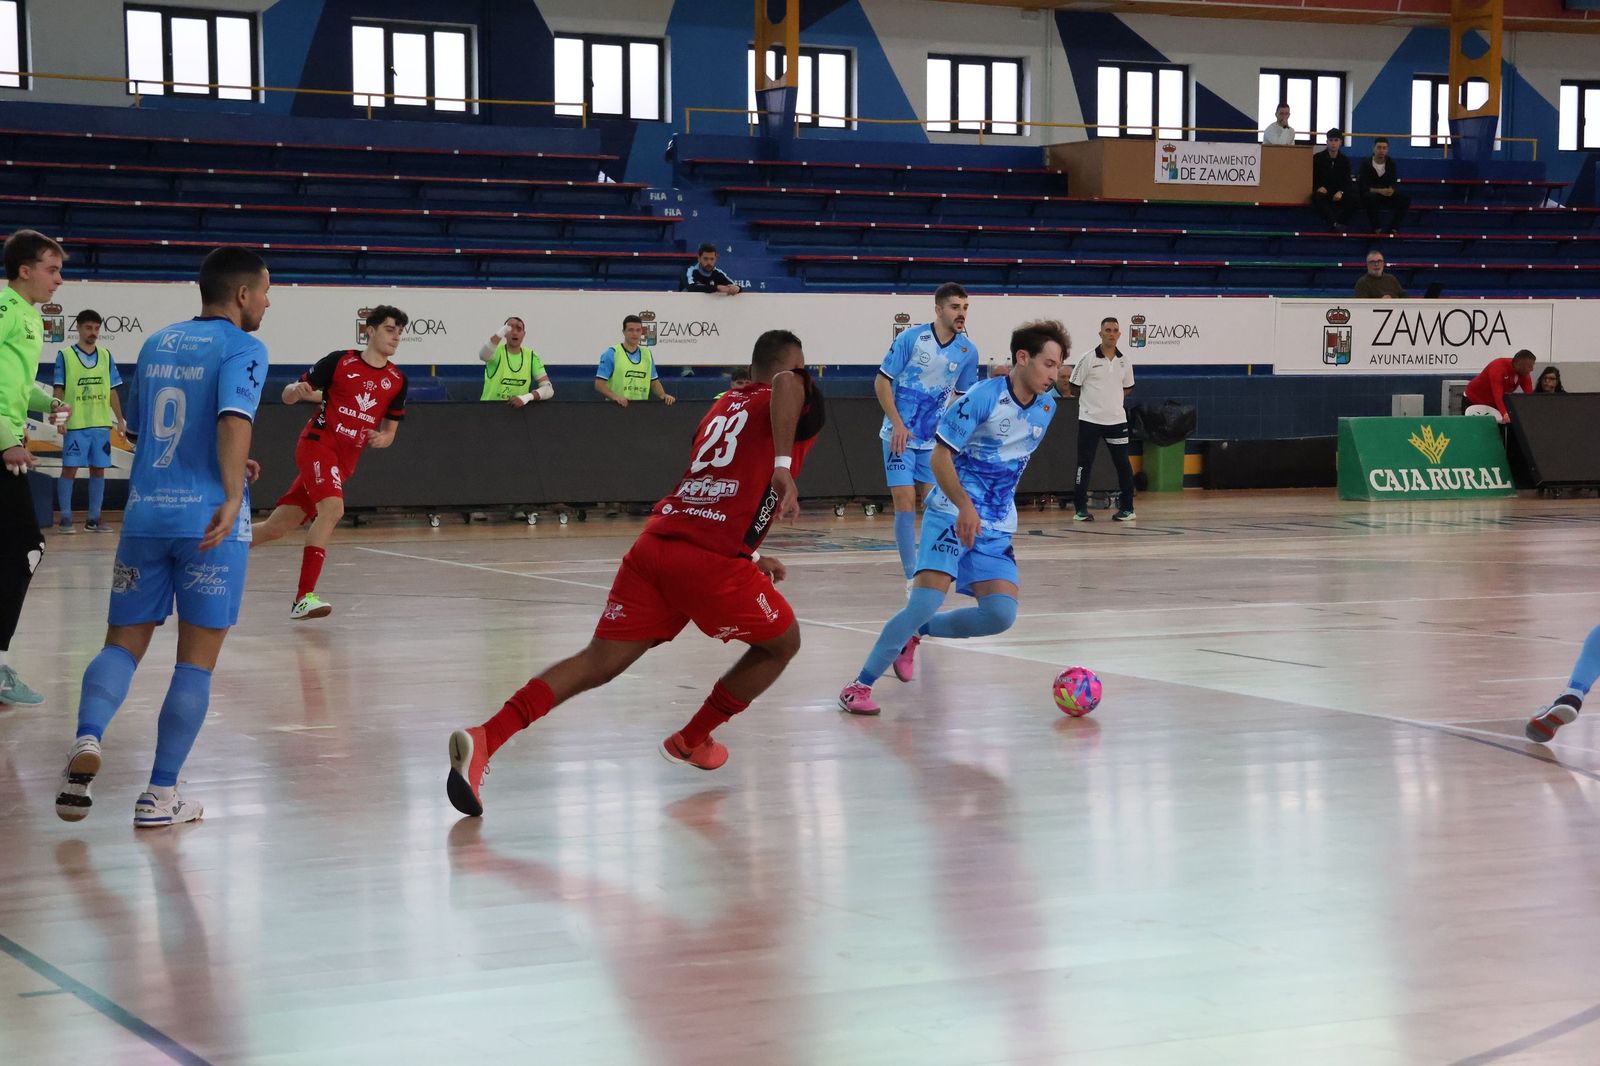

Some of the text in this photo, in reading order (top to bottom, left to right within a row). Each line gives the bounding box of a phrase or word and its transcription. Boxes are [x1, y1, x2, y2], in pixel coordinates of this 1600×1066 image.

[1181, 154, 1257, 166] AYUNTAMIENTO
[1180, 167, 1256, 182] DE ZAMORA
[659, 321, 720, 337] ZAMORA
[1148, 324, 1200, 339] ZAMORA
[1371, 308, 1512, 347] ZAMORA
[1369, 353, 1459, 365] AYUNTAMIENTO
[145, 363, 174, 378] DANI
[338, 406, 357, 417] CAJA
[152, 386, 187, 468] 9
[690, 409, 749, 475] 23
[1369, 467, 1513, 493] CAJA RURAL
[931, 543, 960, 557] ACTIO
